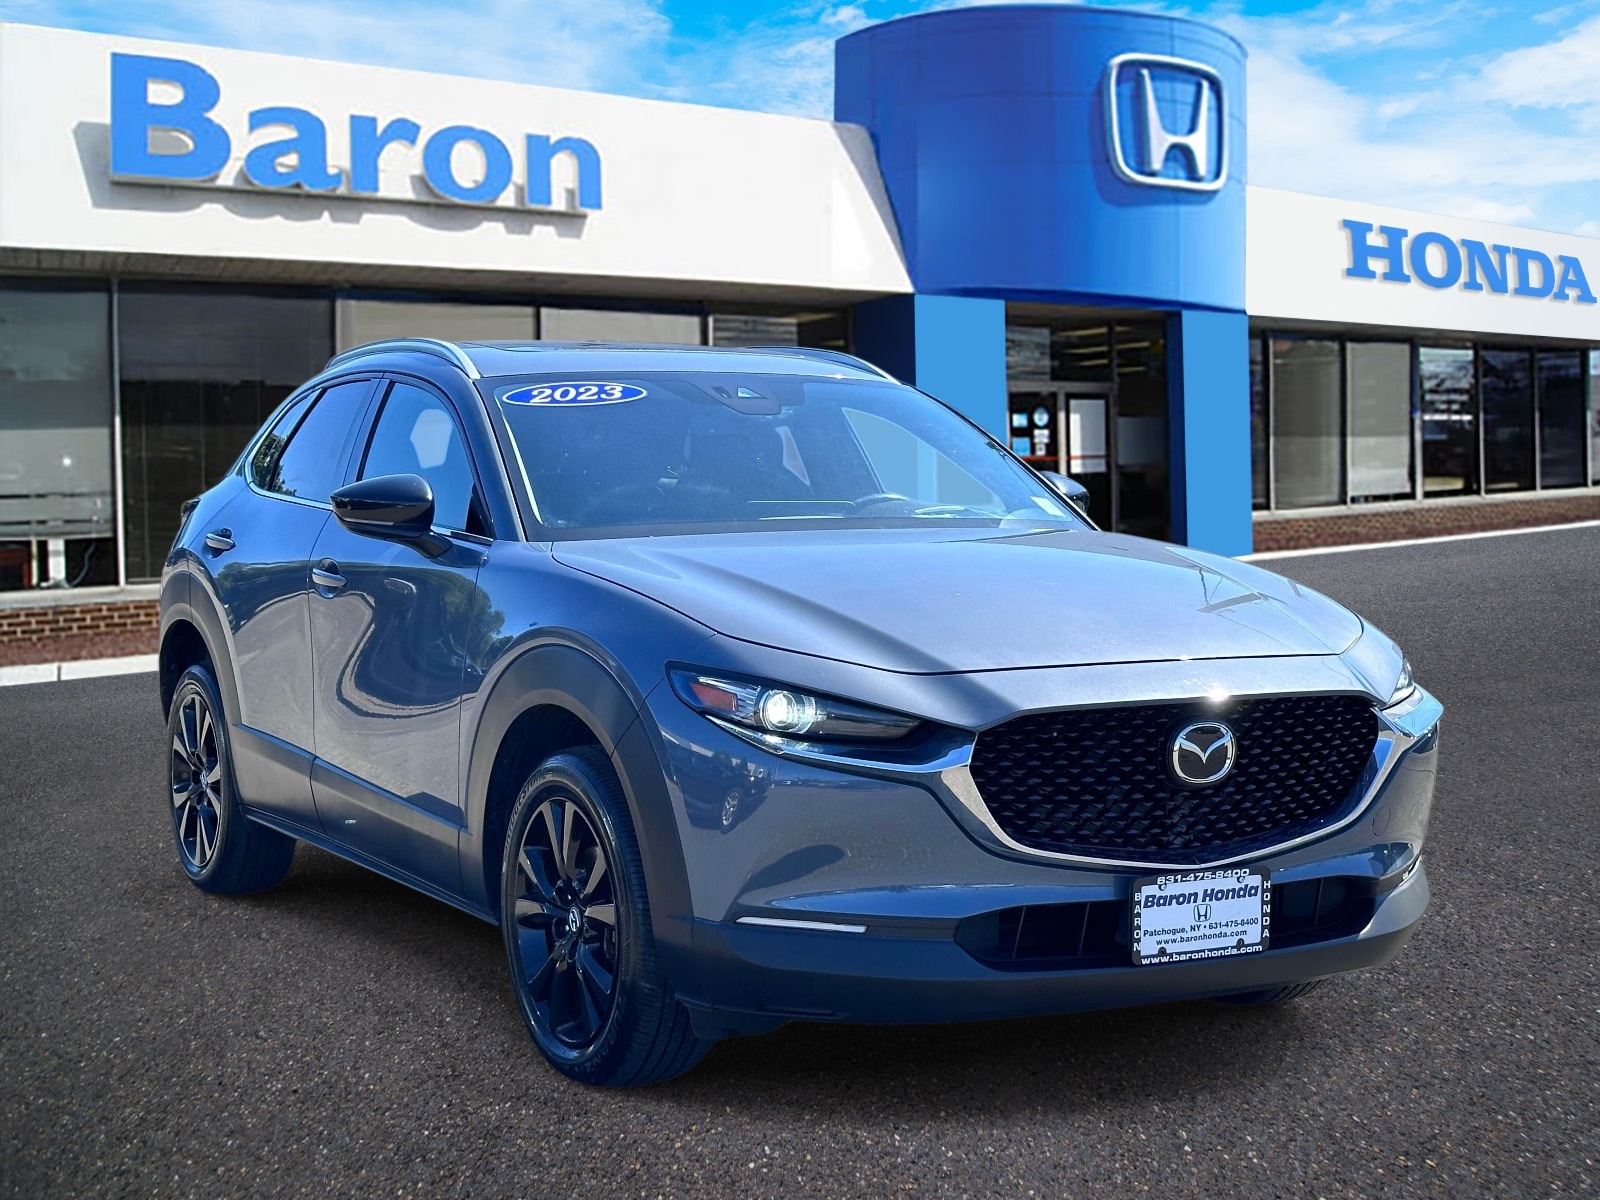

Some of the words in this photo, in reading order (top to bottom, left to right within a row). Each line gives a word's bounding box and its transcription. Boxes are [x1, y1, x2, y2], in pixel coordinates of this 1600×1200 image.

[110, 51, 603, 211] Baron
[1342, 218, 1598, 304] HONDA
[529, 385, 624, 404] 2023
[1157, 869, 1249, 884] 631-475-8400
[1143, 891, 1198, 908] Baron
[1202, 884, 1259, 902] Honda
[1262, 880, 1271, 938] HONDA
[1133, 892, 1141, 951] BARON
[1143, 927, 1188, 937] Patchogue,
[1189, 924, 1202, 932] NY
[1155, 930, 1247, 945] www.baronhonda.com
[1141, 945, 1263, 964] www.baronhonda.com
